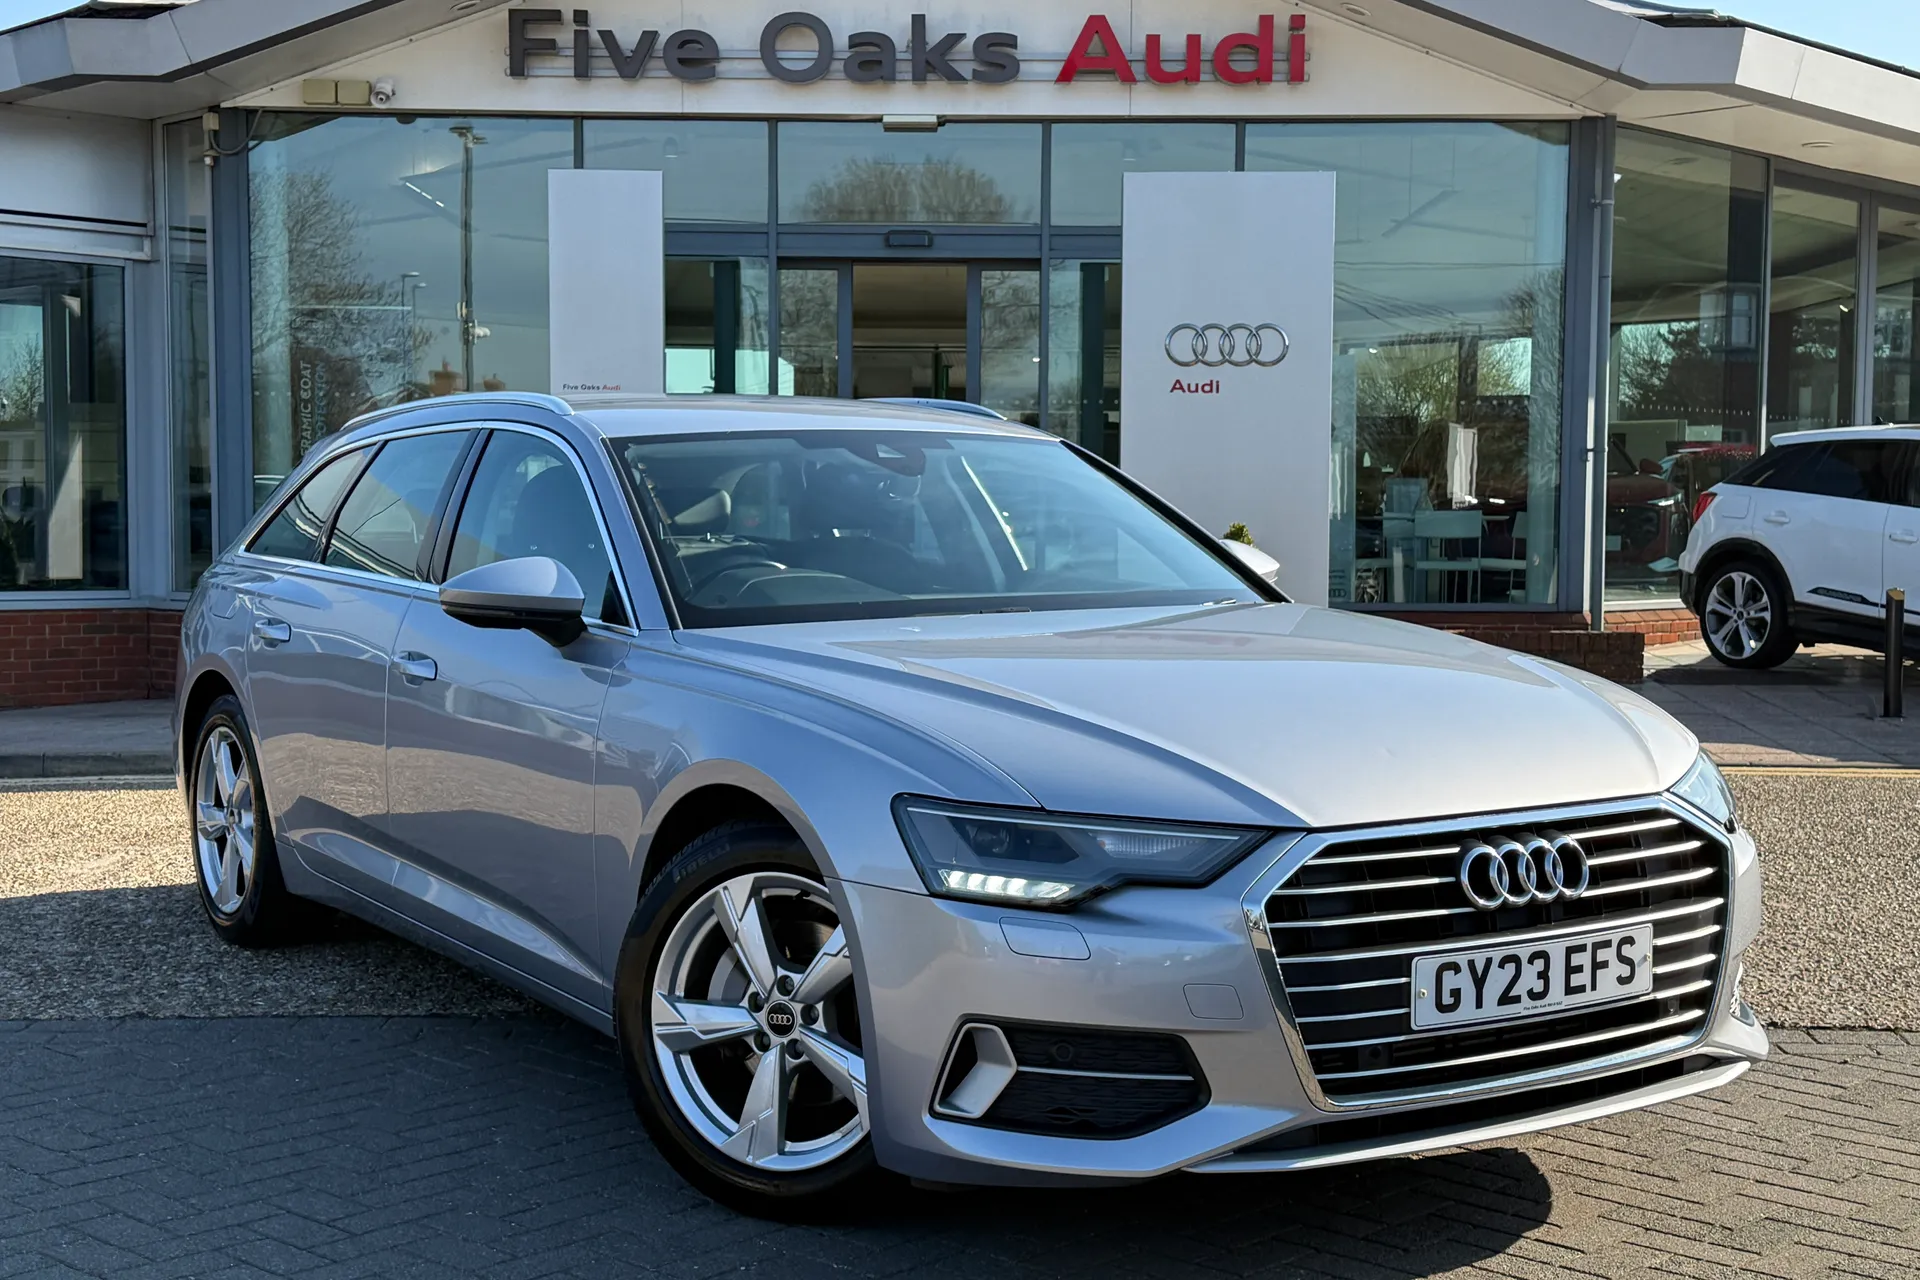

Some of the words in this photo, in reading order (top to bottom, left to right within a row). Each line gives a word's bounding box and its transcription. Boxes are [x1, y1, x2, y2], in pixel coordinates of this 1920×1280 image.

[508, 8, 720, 83] Five
[760, 11, 1020, 84] Oaks
[1054, 14, 1307, 85] Audi
[300, 360, 311, 400] COAT
[562, 383, 579, 391] Five
[580, 383, 600, 391] Oaks
[602, 383, 621, 391] Audi
[1169, 378, 1220, 394] Audi
[1434, 949, 1551, 1014] GY23
[1564, 935, 1637, 997] EFS
